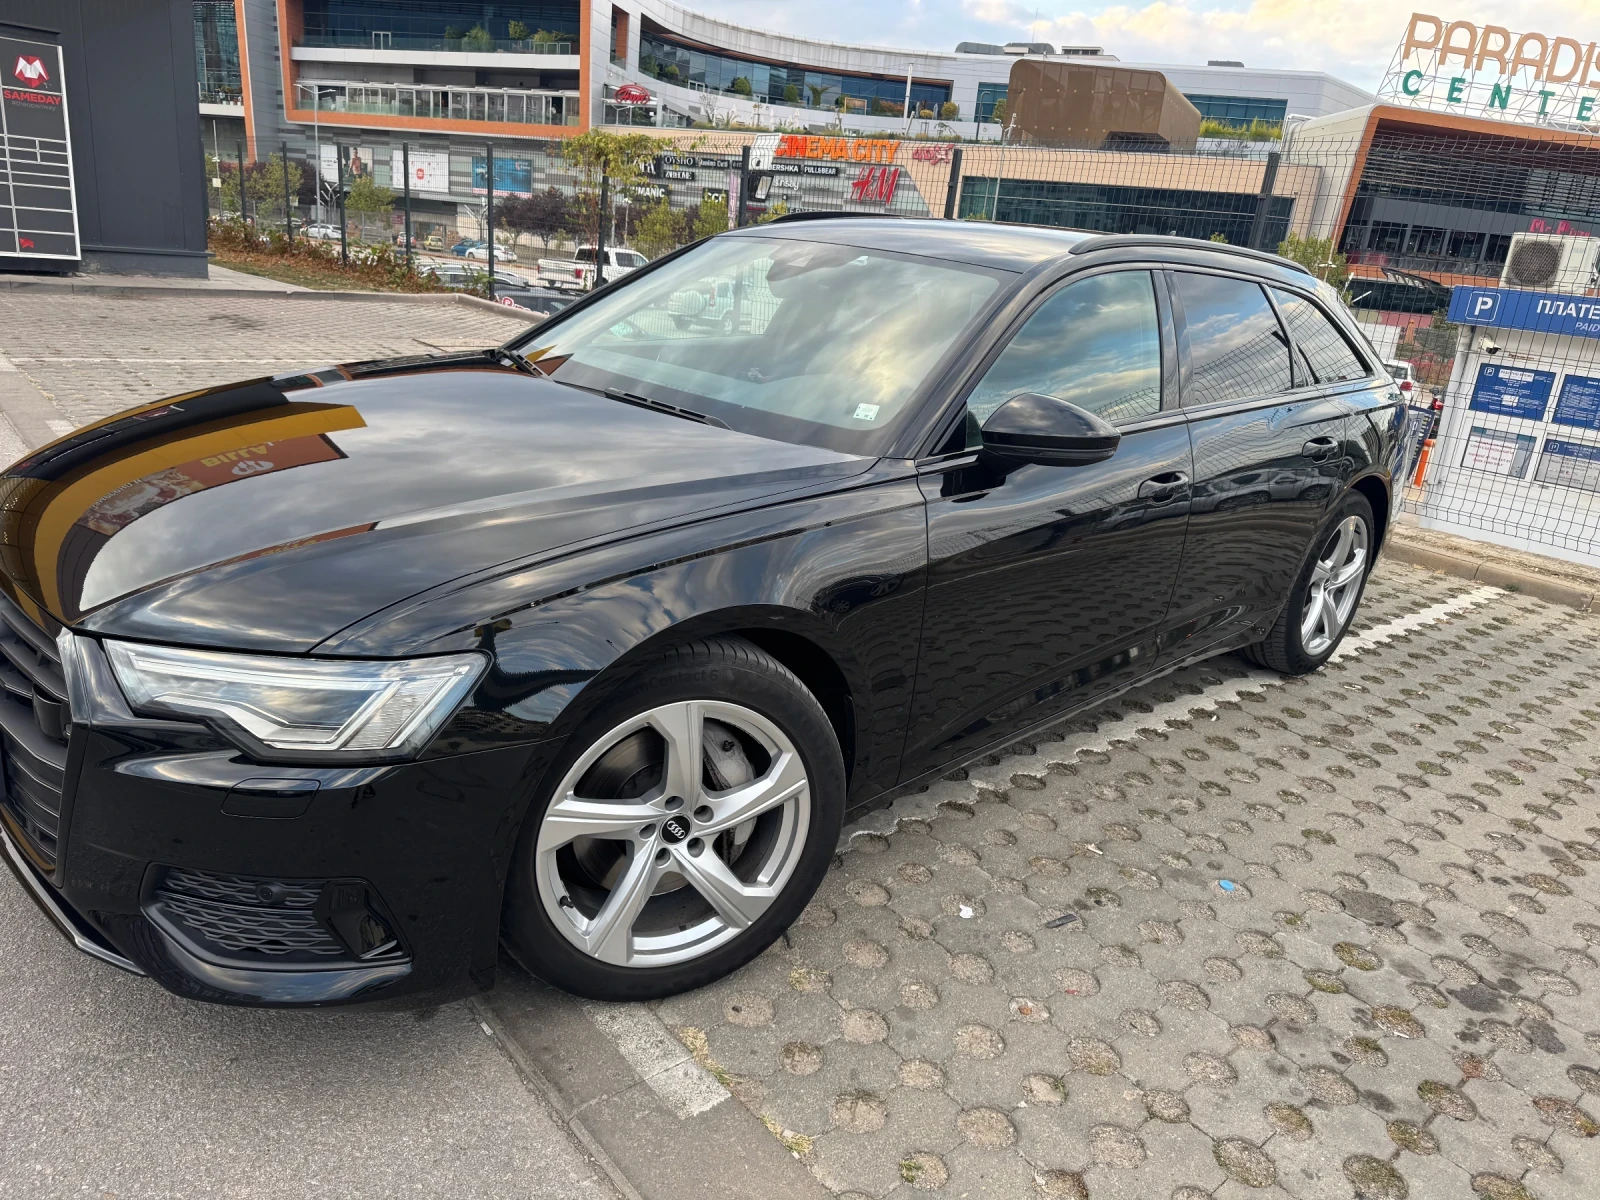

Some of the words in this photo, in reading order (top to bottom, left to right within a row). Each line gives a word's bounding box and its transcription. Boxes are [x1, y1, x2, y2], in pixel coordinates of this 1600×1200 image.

[3, 90, 61, 105] SAMEDAY
[1402, 69, 1595, 122] CENTE
[774, 135, 848, 160] CINEMA
[851, 138, 901, 163] CITY
[665, 156, 693, 166] OYSHO
[768, 164, 799, 172] BERSHKA
[804, 166, 836, 175] PULL&BEAR
[850, 166, 900, 205] H&M
[1474, 296, 1493, 316] P
[1575, 322, 1600, 332] PAID
